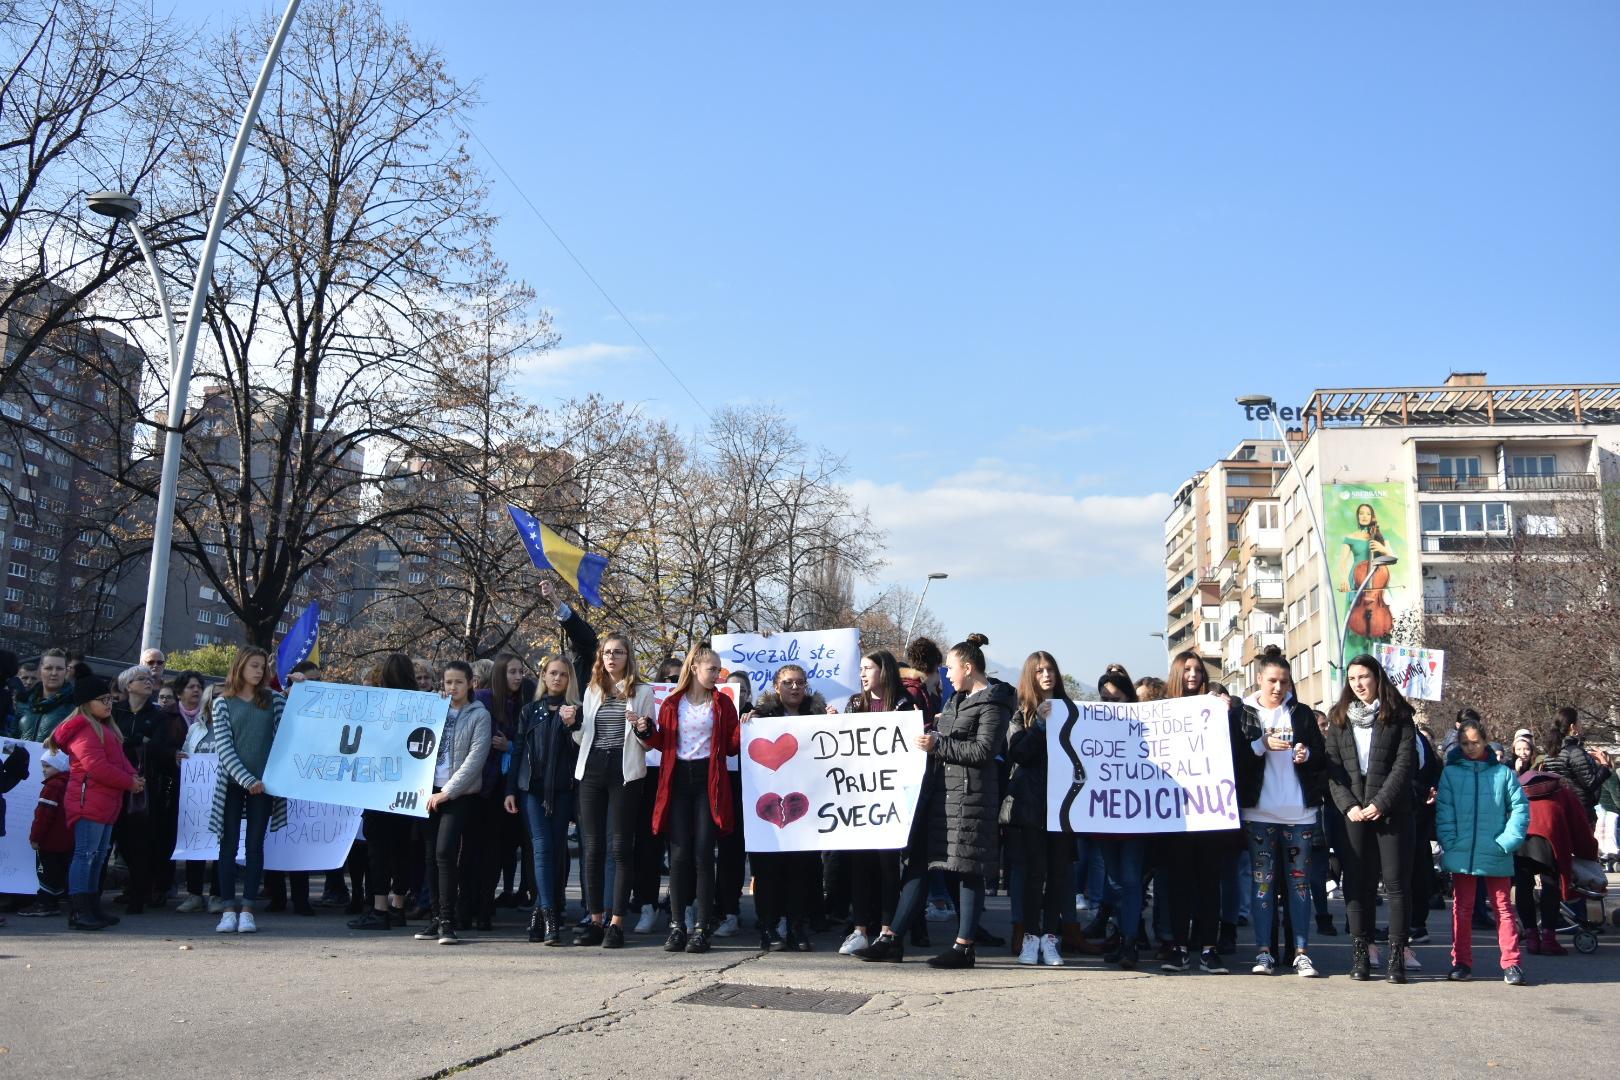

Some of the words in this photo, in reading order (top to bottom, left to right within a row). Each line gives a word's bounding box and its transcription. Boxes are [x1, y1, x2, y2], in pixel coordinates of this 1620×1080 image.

[731, 639, 801, 664] Svezali
[810, 643, 836, 660] ste
[807, 663, 841, 679] dost
[1083, 703, 1172, 722] MEDICINSKE
[339, 724, 363, 755] U
[1128, 716, 1193, 737] METODE
[811, 726, 909, 760] DJECA
[1080, 738, 1126, 759] GDJE
[1137, 738, 1171, 759] STE
[1187, 733, 1205, 753] VI
[184, 760, 218, 783] NAM
[293, 753, 403, 783] VREMENU
[1098, 756, 1211, 782] STUDIRALI
[826, 767, 898, 796] PRIJE
[1088, 778, 1237, 821] MEDICINU?
[817, 801, 902, 834] SVEGA
